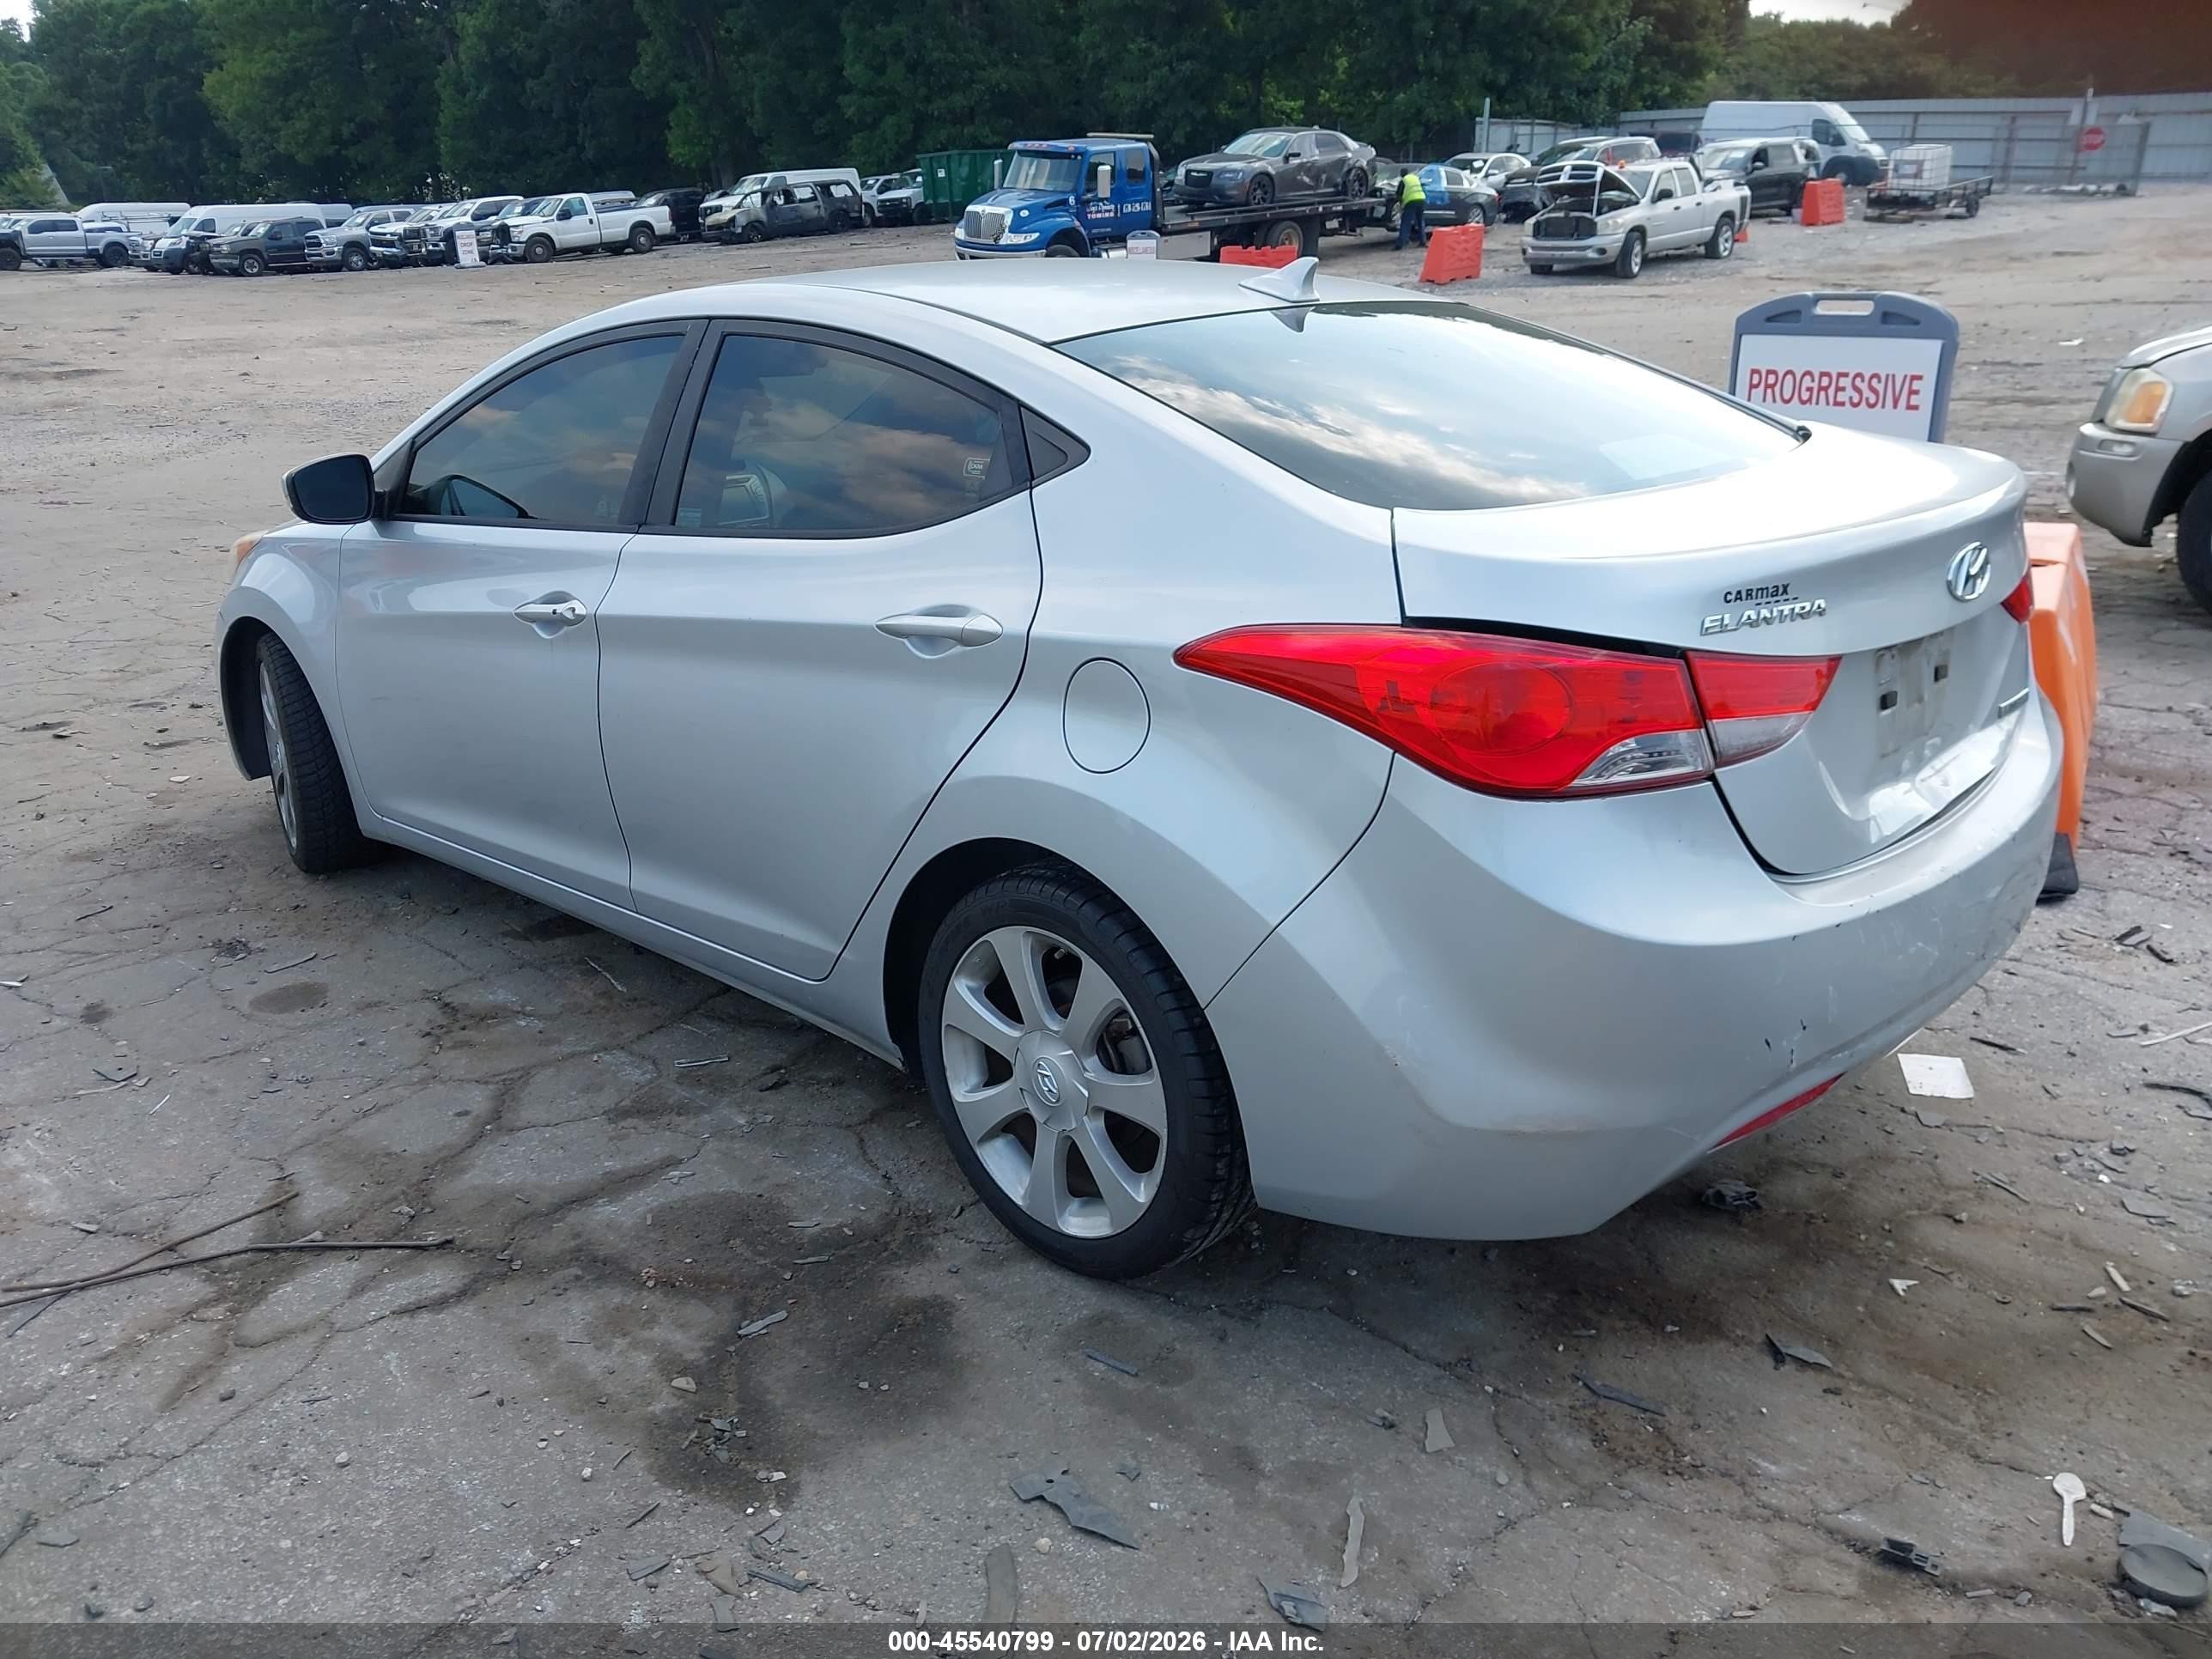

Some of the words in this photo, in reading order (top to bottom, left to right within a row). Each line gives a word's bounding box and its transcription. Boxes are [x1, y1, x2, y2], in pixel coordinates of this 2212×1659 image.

[1068, 196, 1076, 205] 6
[1087, 211, 1115, 220] TOWING
[1747, 368, 1924, 410] PROGRESSIVE
[1700, 599, 1826, 636] ELANTRA
